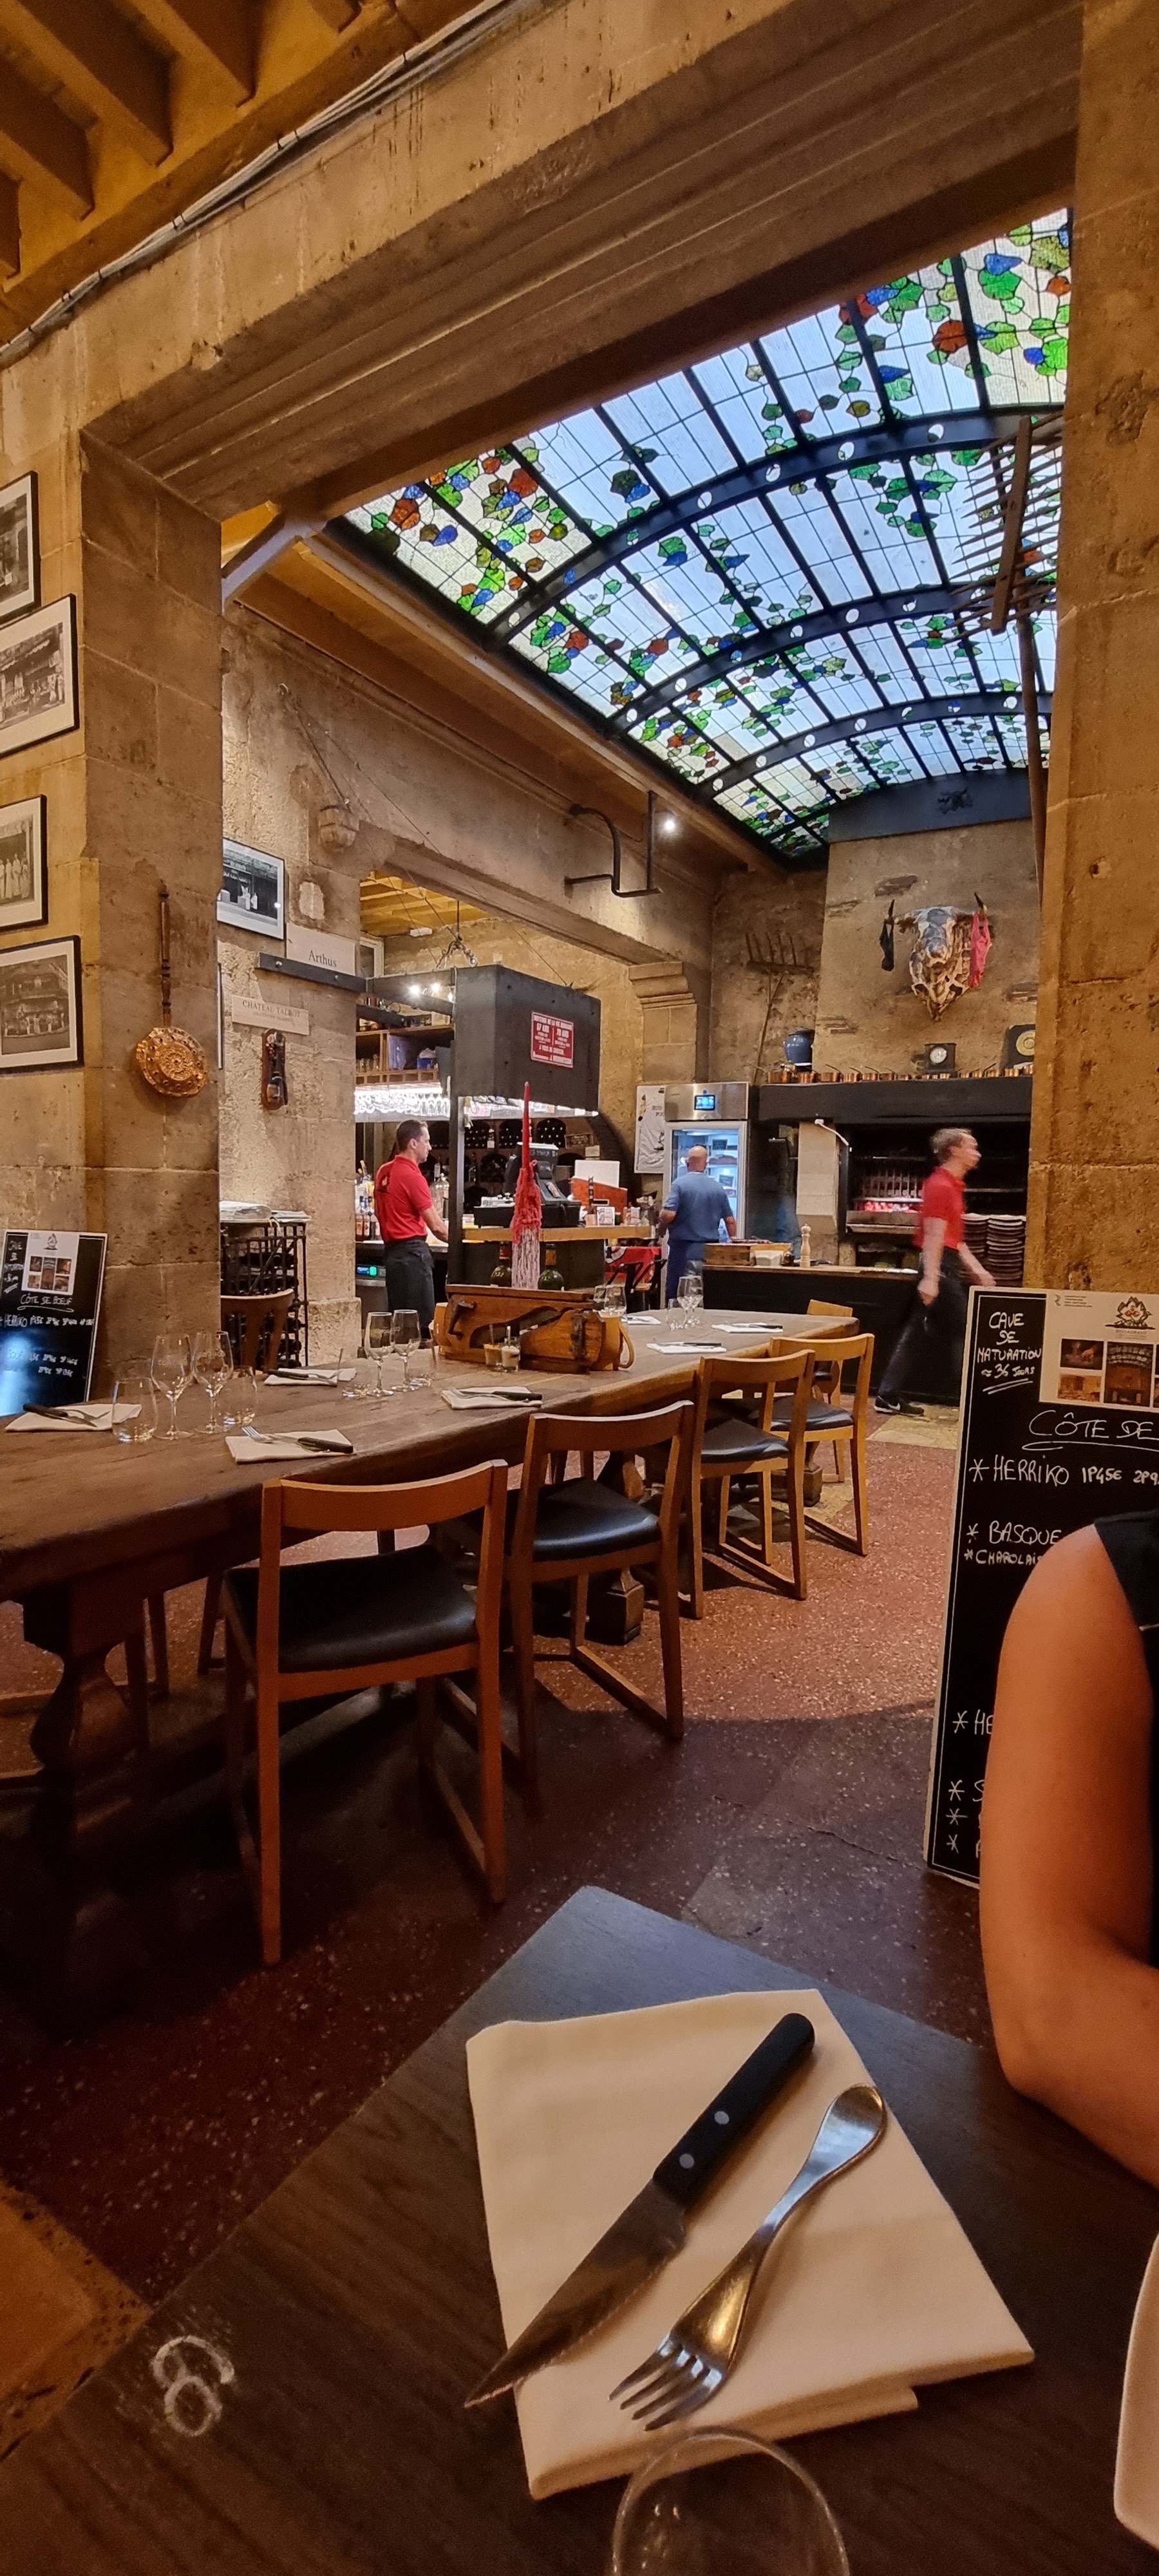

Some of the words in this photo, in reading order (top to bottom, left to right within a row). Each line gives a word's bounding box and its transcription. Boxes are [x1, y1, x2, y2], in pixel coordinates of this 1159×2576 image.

[309, 950, 337, 967] Arthus
[276, 1008, 300, 1018] TALBOT
[989, 1312, 1024, 1329] CAVE
[996, 1330, 1019, 1345] DE
[977, 1347, 1041, 1363] MATURATION
[994, 1363, 1010, 1378] 36
[1029, 1410, 1109, 1437] CÔTE
[1117, 1421, 1159, 1441] DE
[994, 1454, 1069, 1486] HERRIKO
[1133, 1470, 1159, 1486] 2P9
[989, 1520, 1062, 1545] BASQUE
